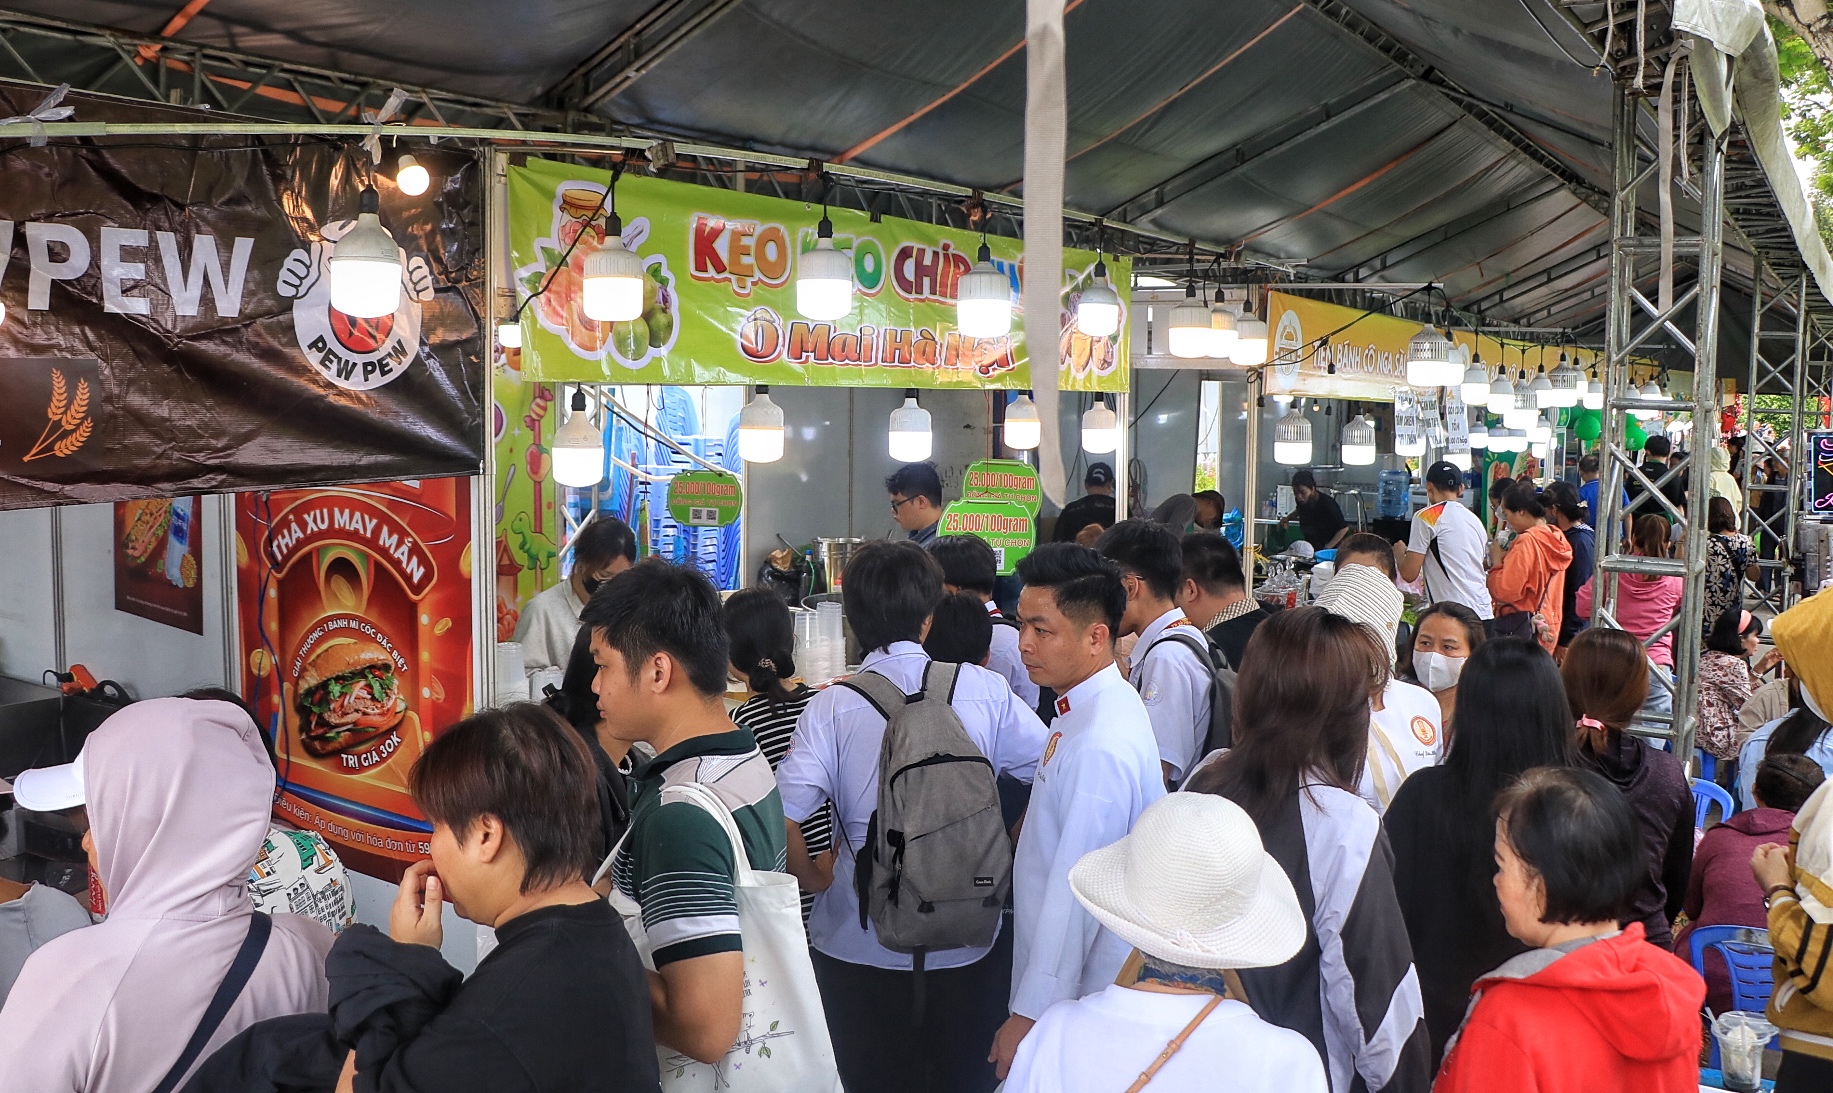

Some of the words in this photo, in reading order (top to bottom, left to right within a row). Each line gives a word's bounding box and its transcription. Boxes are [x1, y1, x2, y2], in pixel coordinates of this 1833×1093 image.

[0, 221, 254, 317] PEW
[690, 213, 791, 296] KẸO
[307, 334, 357, 382] PEW
[362, 338, 409, 382] PEW
[740, 306, 782, 362] Ô
[787, 321, 876, 366] Mai
[881, 327, 942, 368] Hà
[1336, 339, 1361, 373] BÁNH
[1362, 343, 1376, 373] CÔ
[1376, 350, 1393, 375] NGA
[673, 481, 736, 496] 25.000/100gram
[969, 471, 1035, 490] 25.000/100gram
[271, 514, 304, 561] THẢ
[303, 508, 329, 535] XU
[333, 507, 378, 539] MAY
[378, 524, 425, 584] MẮN
[945, 513, 1028, 534] 25.000/100gram
[1004, 538, 1030, 550] CHỌN
[328, 617, 348, 631] BÁNH
[349, 618, 359, 630] MÌ
[391, 649, 408, 673] BIỆT
[341, 753, 360, 770] TRỊ
[360, 746, 380, 767] GIÁ
[379, 730, 402, 758] 30K
[293, 803, 313, 823] kiện:
[314, 813, 326, 831] Áp
[327, 822, 350, 841] dụng
[350, 827, 365, 843] với
[366, 832, 384, 848] hóa
[385, 836, 404, 853] đơn
[405, 839, 416, 853] từ
[418, 841, 432, 855] 59
